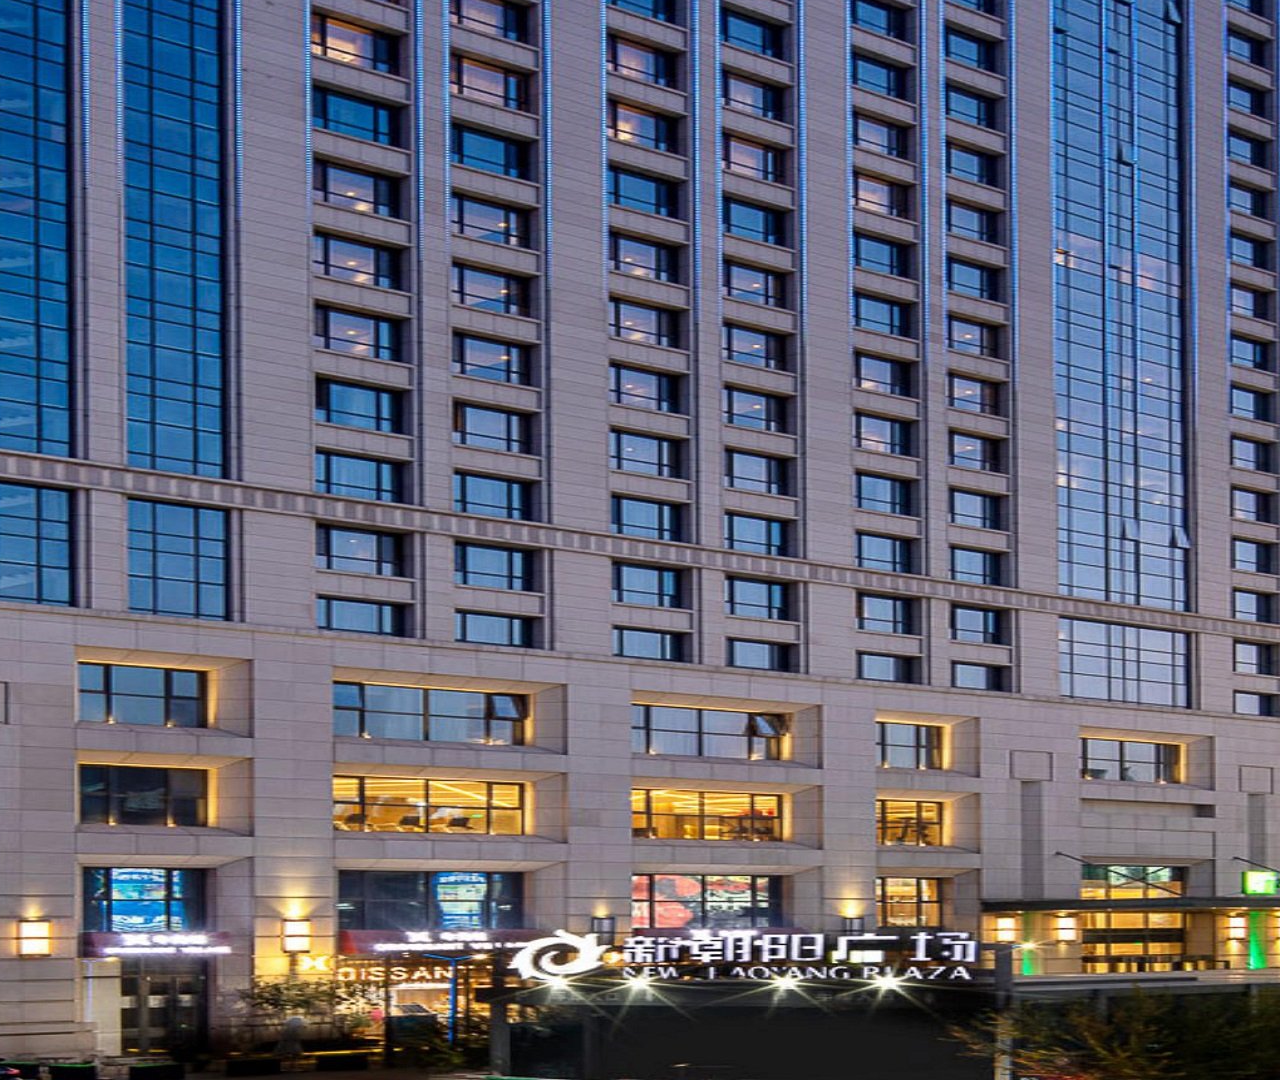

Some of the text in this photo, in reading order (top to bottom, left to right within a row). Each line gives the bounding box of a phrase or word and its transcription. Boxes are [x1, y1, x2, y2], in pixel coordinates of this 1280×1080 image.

[622, 929, 978, 963] 新朝阳广场
[623, 966, 679, 980] NEW
[686, 966, 851, 980] AOYANG
